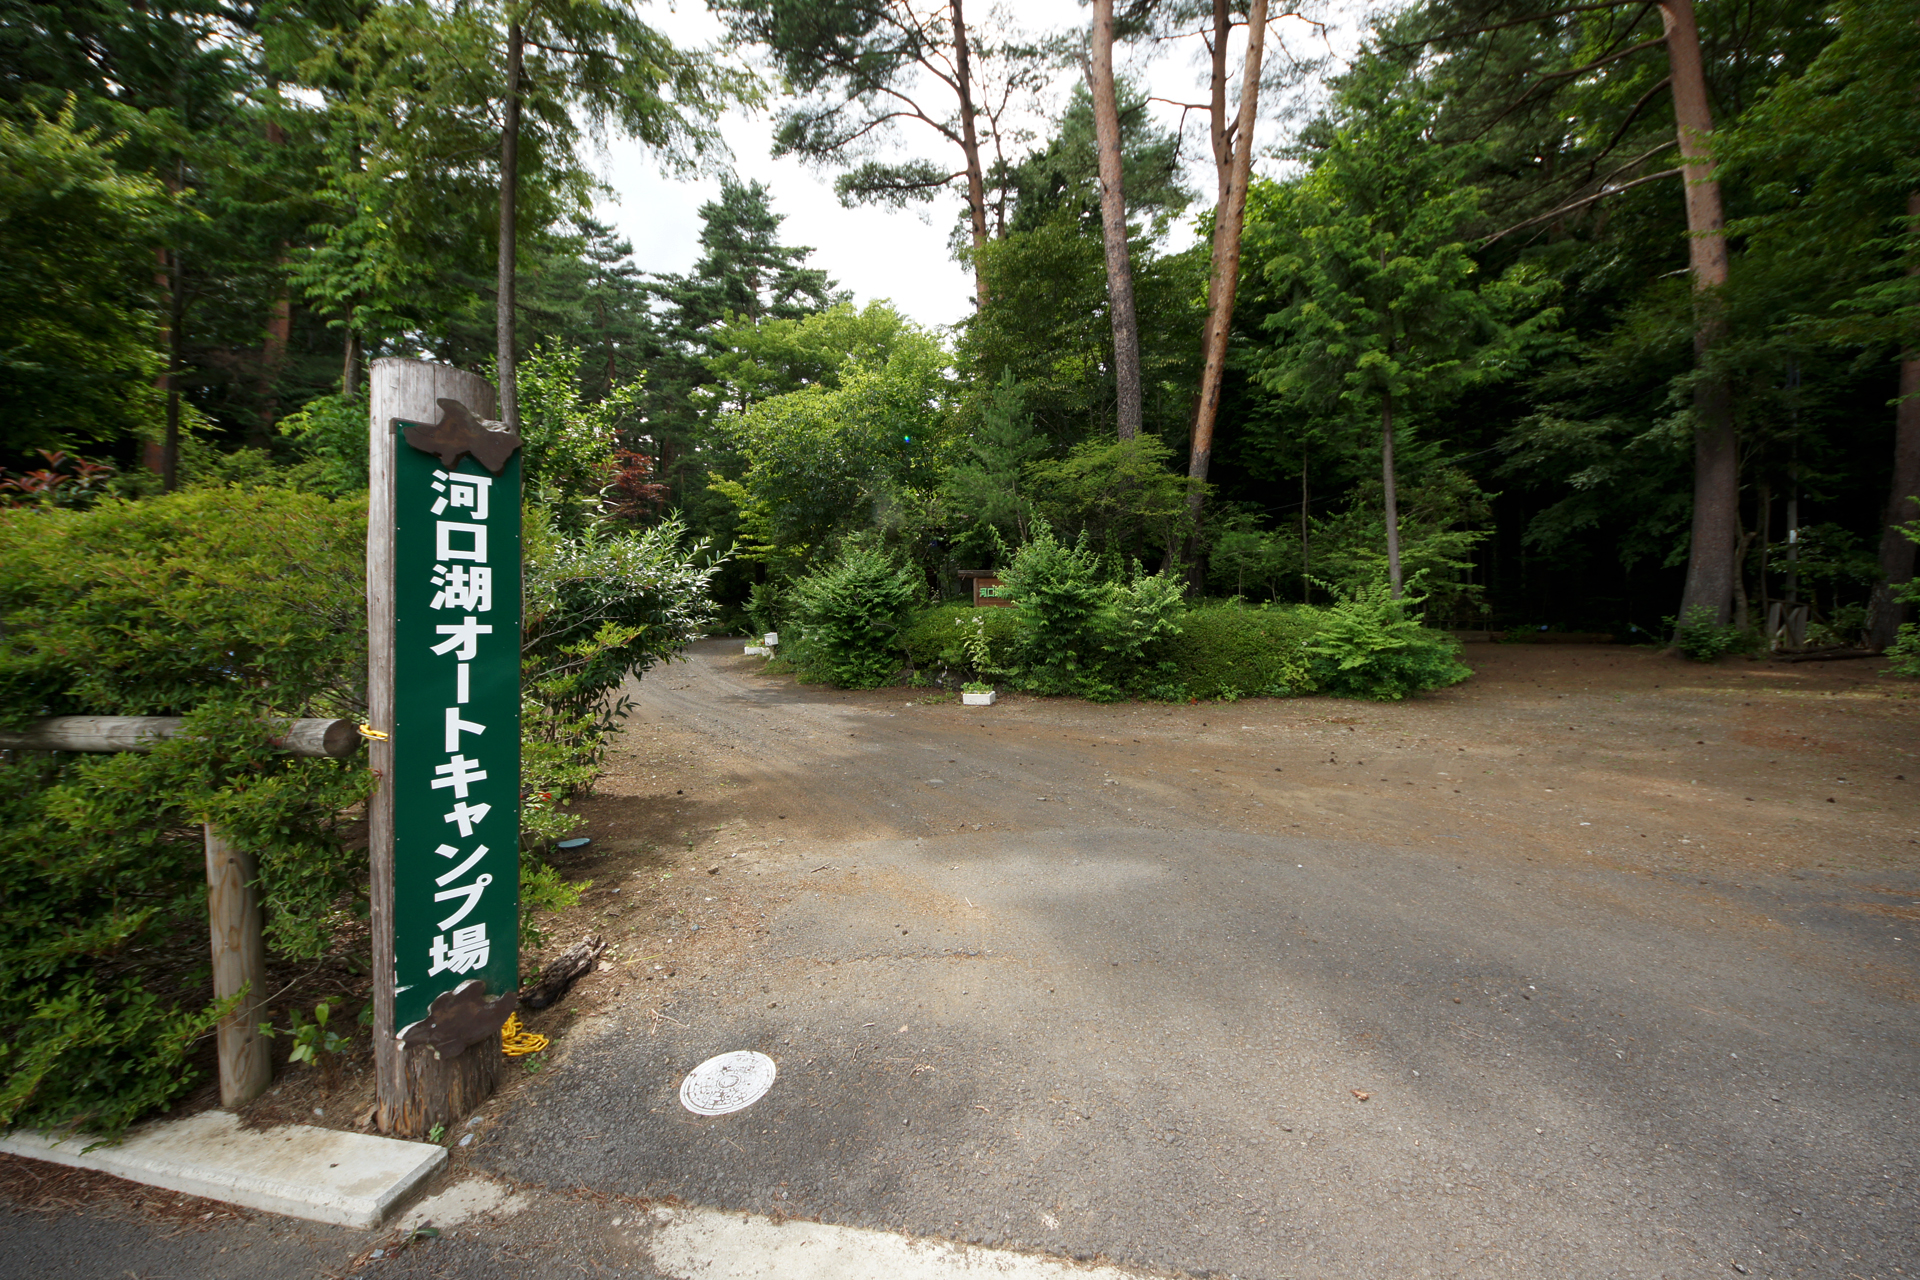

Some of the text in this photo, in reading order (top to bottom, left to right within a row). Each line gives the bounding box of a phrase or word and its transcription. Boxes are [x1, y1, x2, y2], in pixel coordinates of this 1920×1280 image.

[429, 469, 492, 977] 河口湖オートキャンプ場
